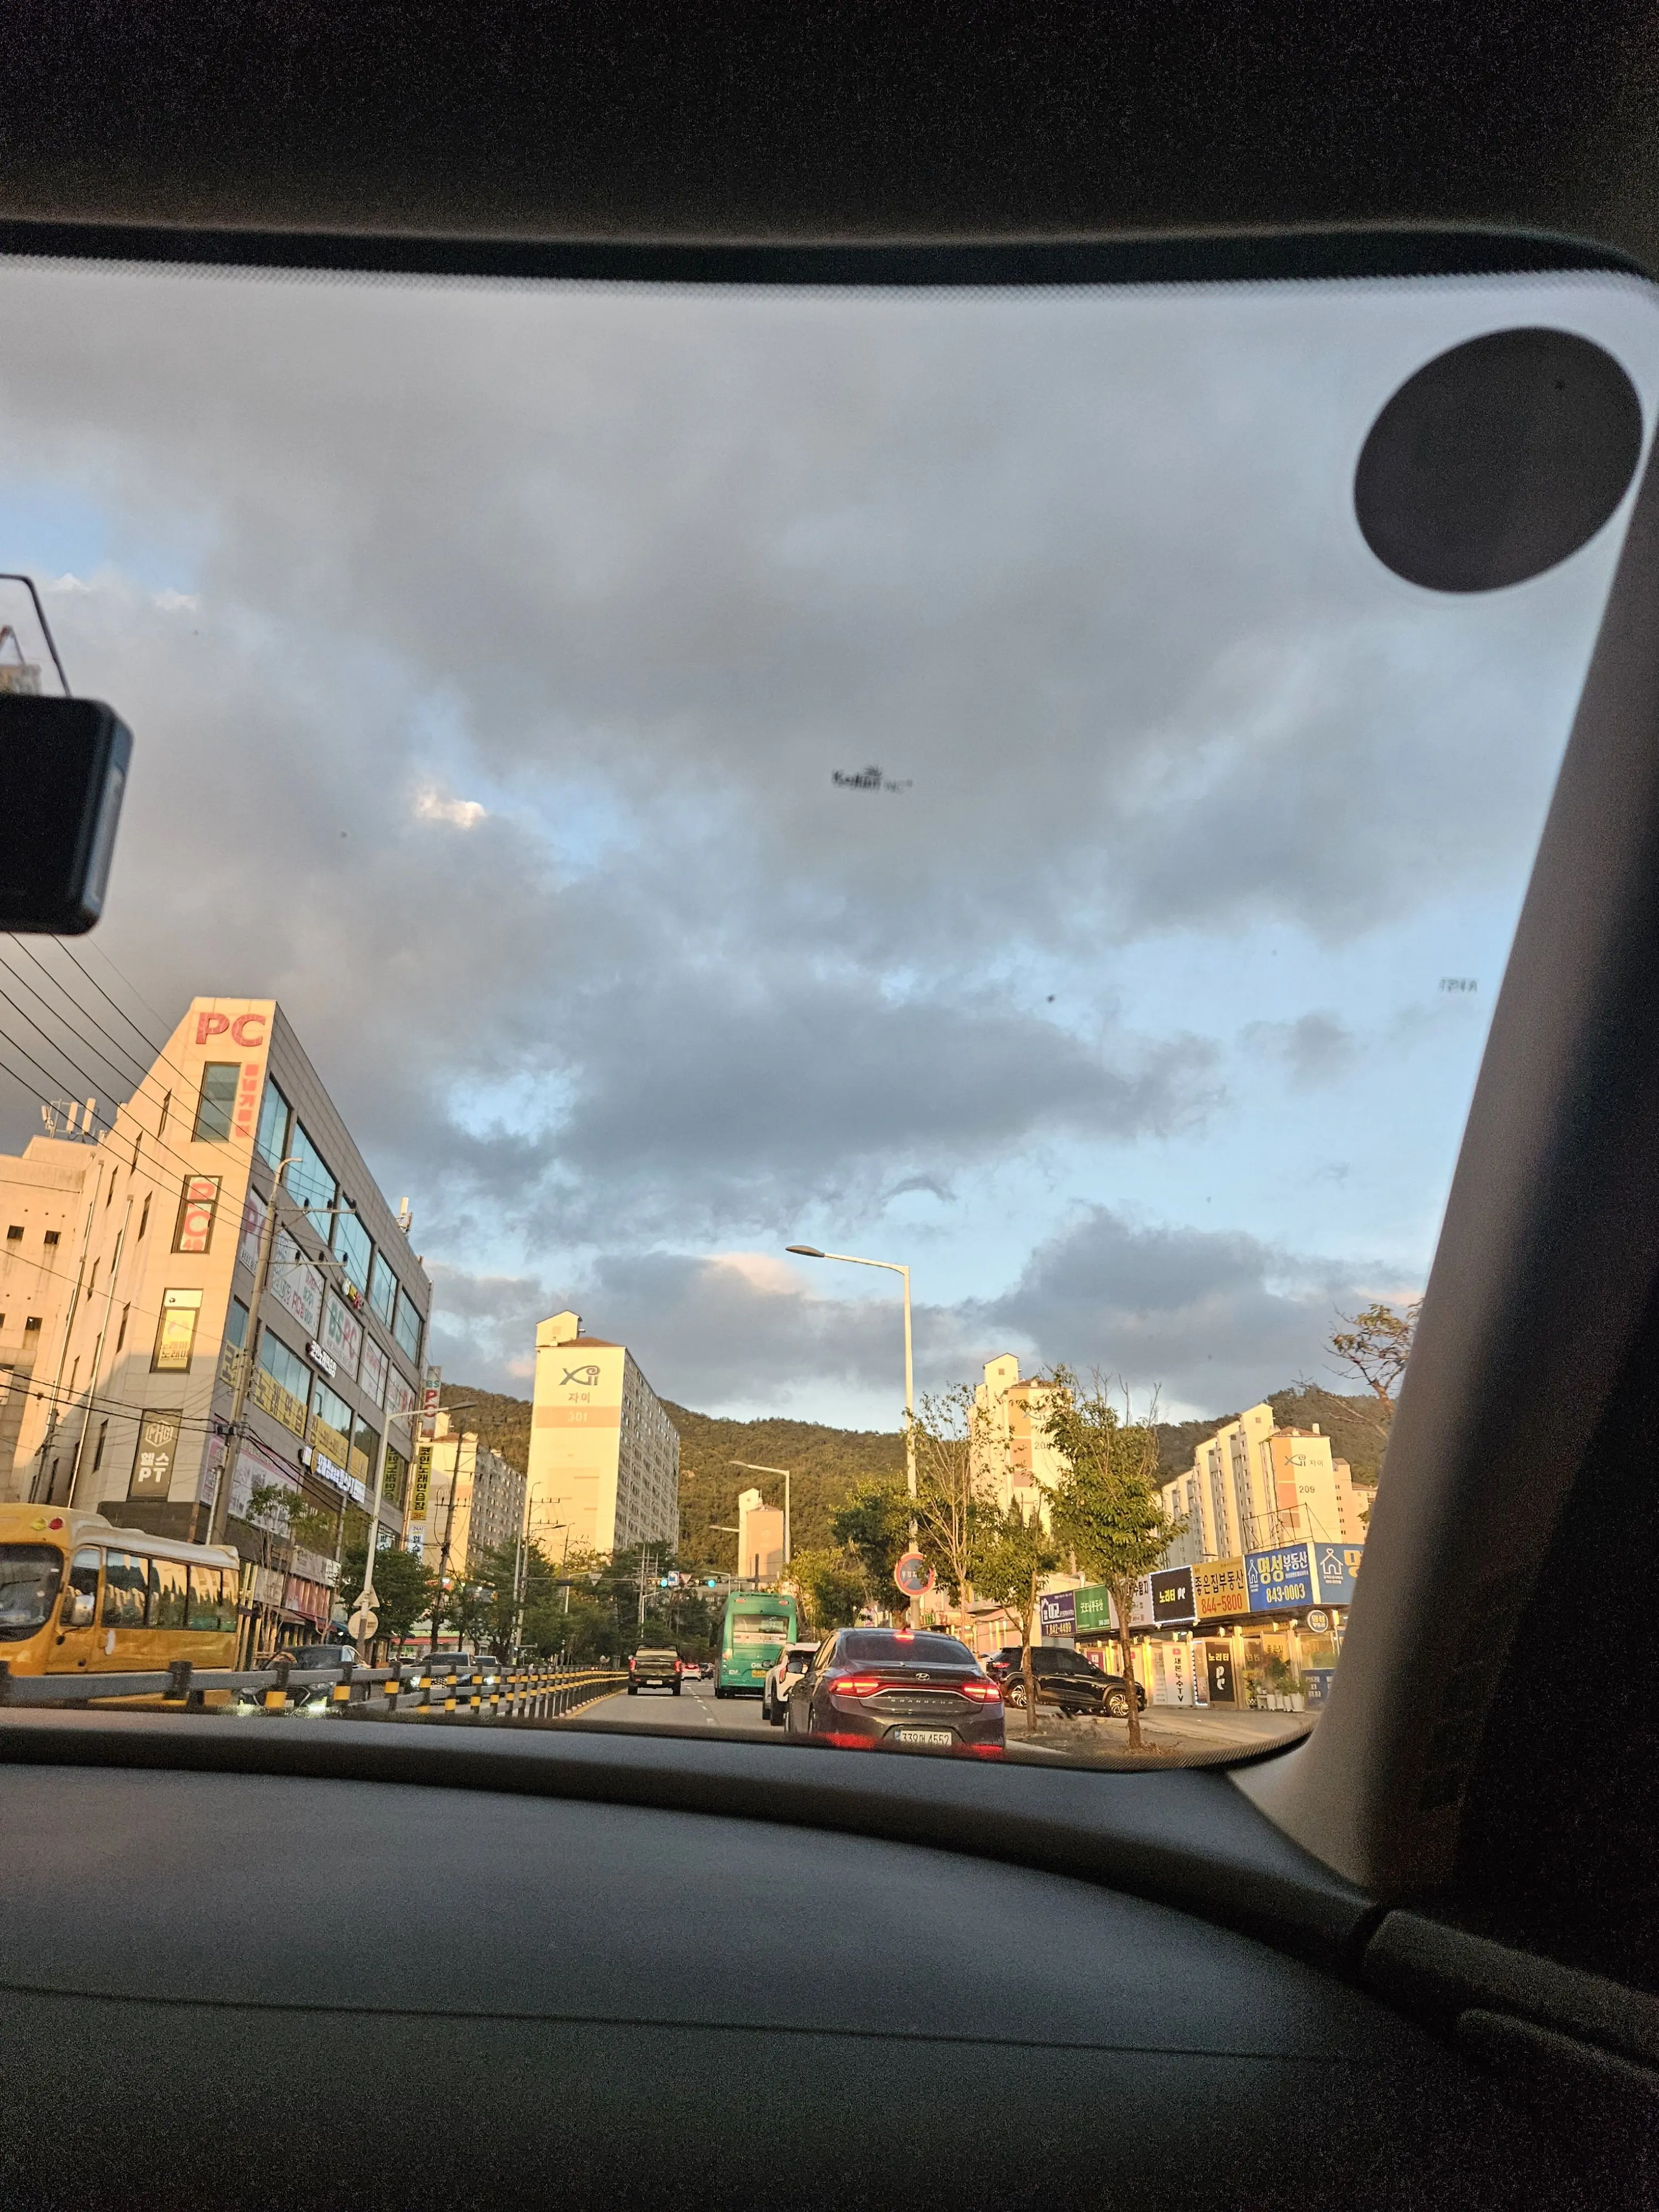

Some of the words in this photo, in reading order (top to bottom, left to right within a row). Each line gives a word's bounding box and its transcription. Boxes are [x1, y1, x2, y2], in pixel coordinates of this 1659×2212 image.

[196, 1012, 266, 1047] PC
[568, 1392, 590, 1404] 자이
[568, 1411, 588, 1422] 301
[140, 1452, 169, 1466] 헬스
[138, 1467, 166, 1483] PT
[415, 1447, 431, 1511] 코인노래연습장
[1257, 1554, 1284, 1584] 명성
[1283, 1551, 1308, 1571] 부동산
[1195, 1569, 1244, 1596] 좋은집부동산
[1202, 1593, 1242, 1614] 844-5800
[1208, 1652, 1229, 1661] 노리터
